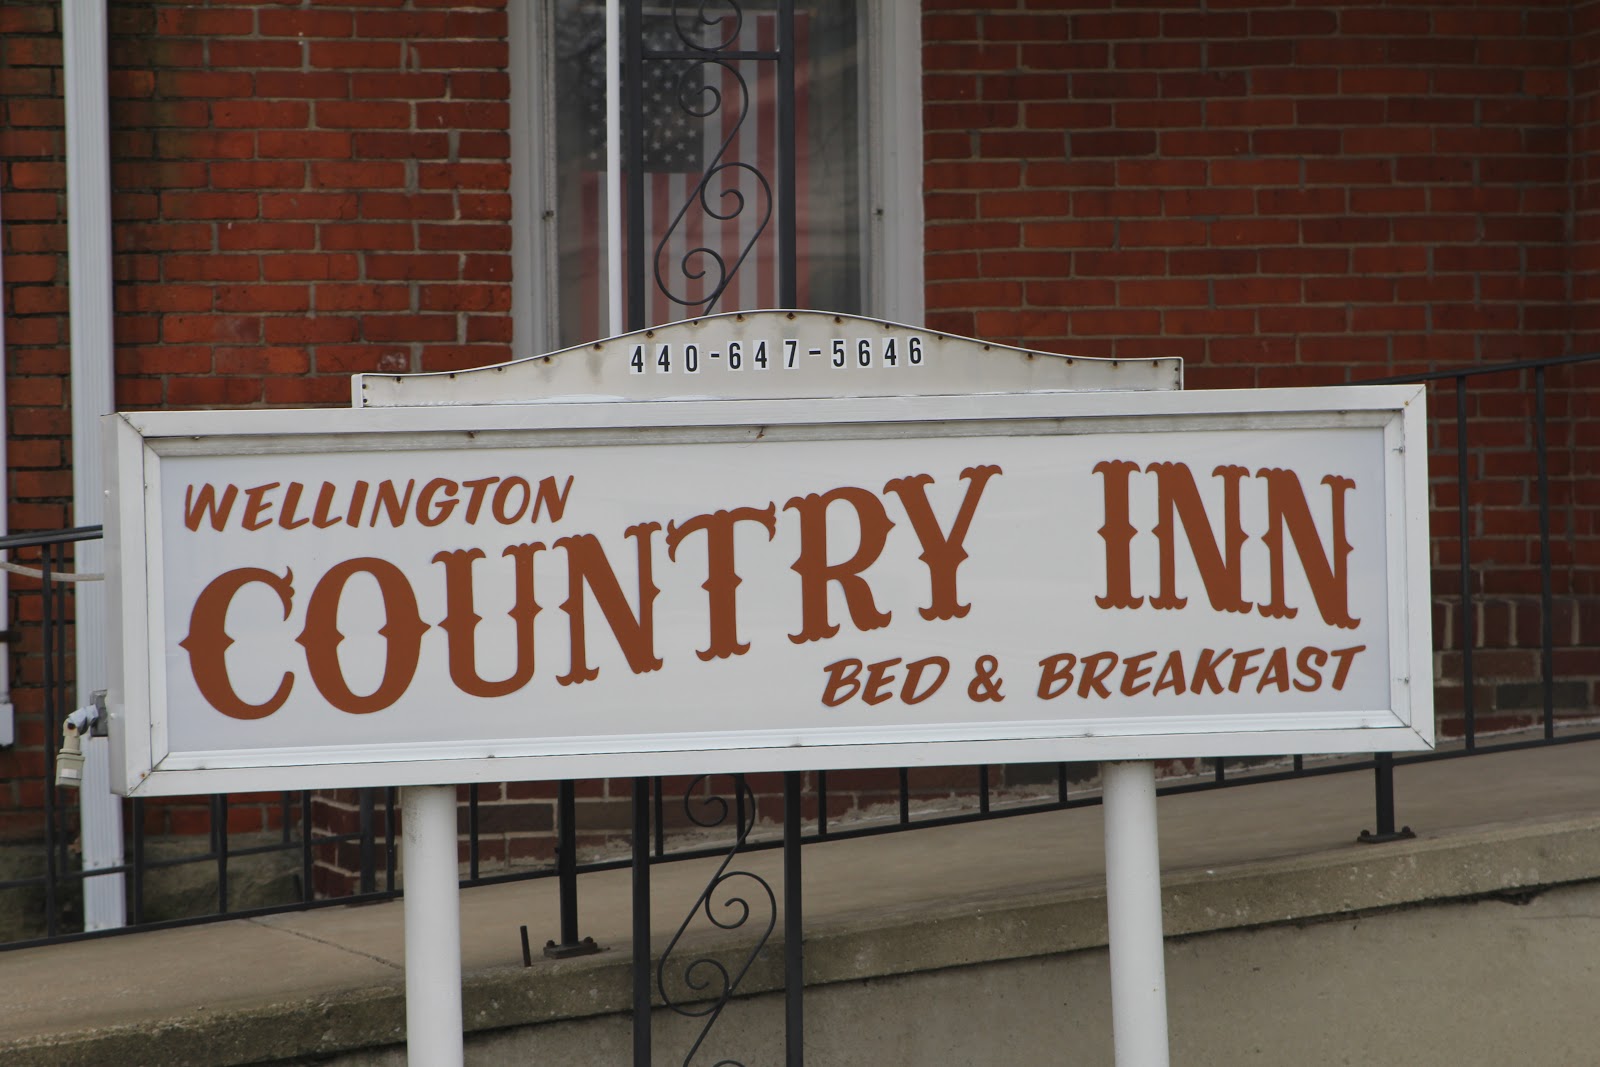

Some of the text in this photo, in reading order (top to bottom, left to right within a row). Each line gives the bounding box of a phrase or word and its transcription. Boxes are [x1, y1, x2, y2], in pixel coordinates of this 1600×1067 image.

[630, 337, 922, 373] 440-647-5646
[185, 475, 575, 533] WELLINGTON
[180, 459, 1361, 721] COUNTRY INN
[822, 645, 1366, 708] BED & BREAKFAST
